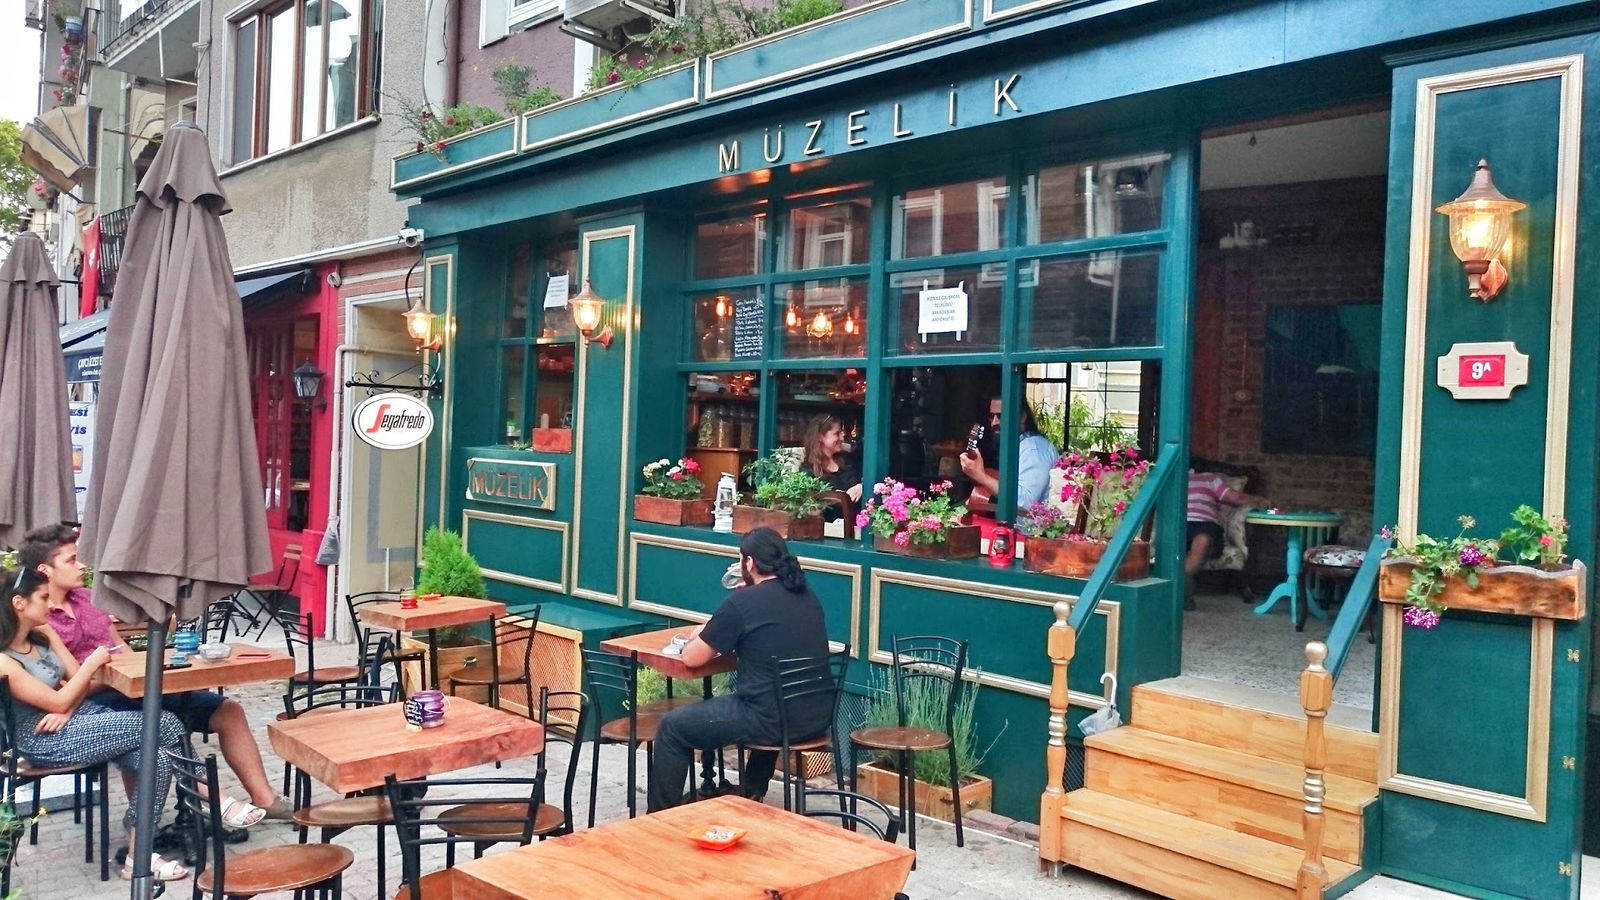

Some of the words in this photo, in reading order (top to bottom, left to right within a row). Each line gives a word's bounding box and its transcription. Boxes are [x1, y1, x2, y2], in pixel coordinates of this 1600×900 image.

[718, 73, 1022, 174] MÜZELİK
[1471, 361, 1492, 380] 9A
[365, 404, 426, 434] Segafredo
[471, 467, 546, 502] MÜZELİK
